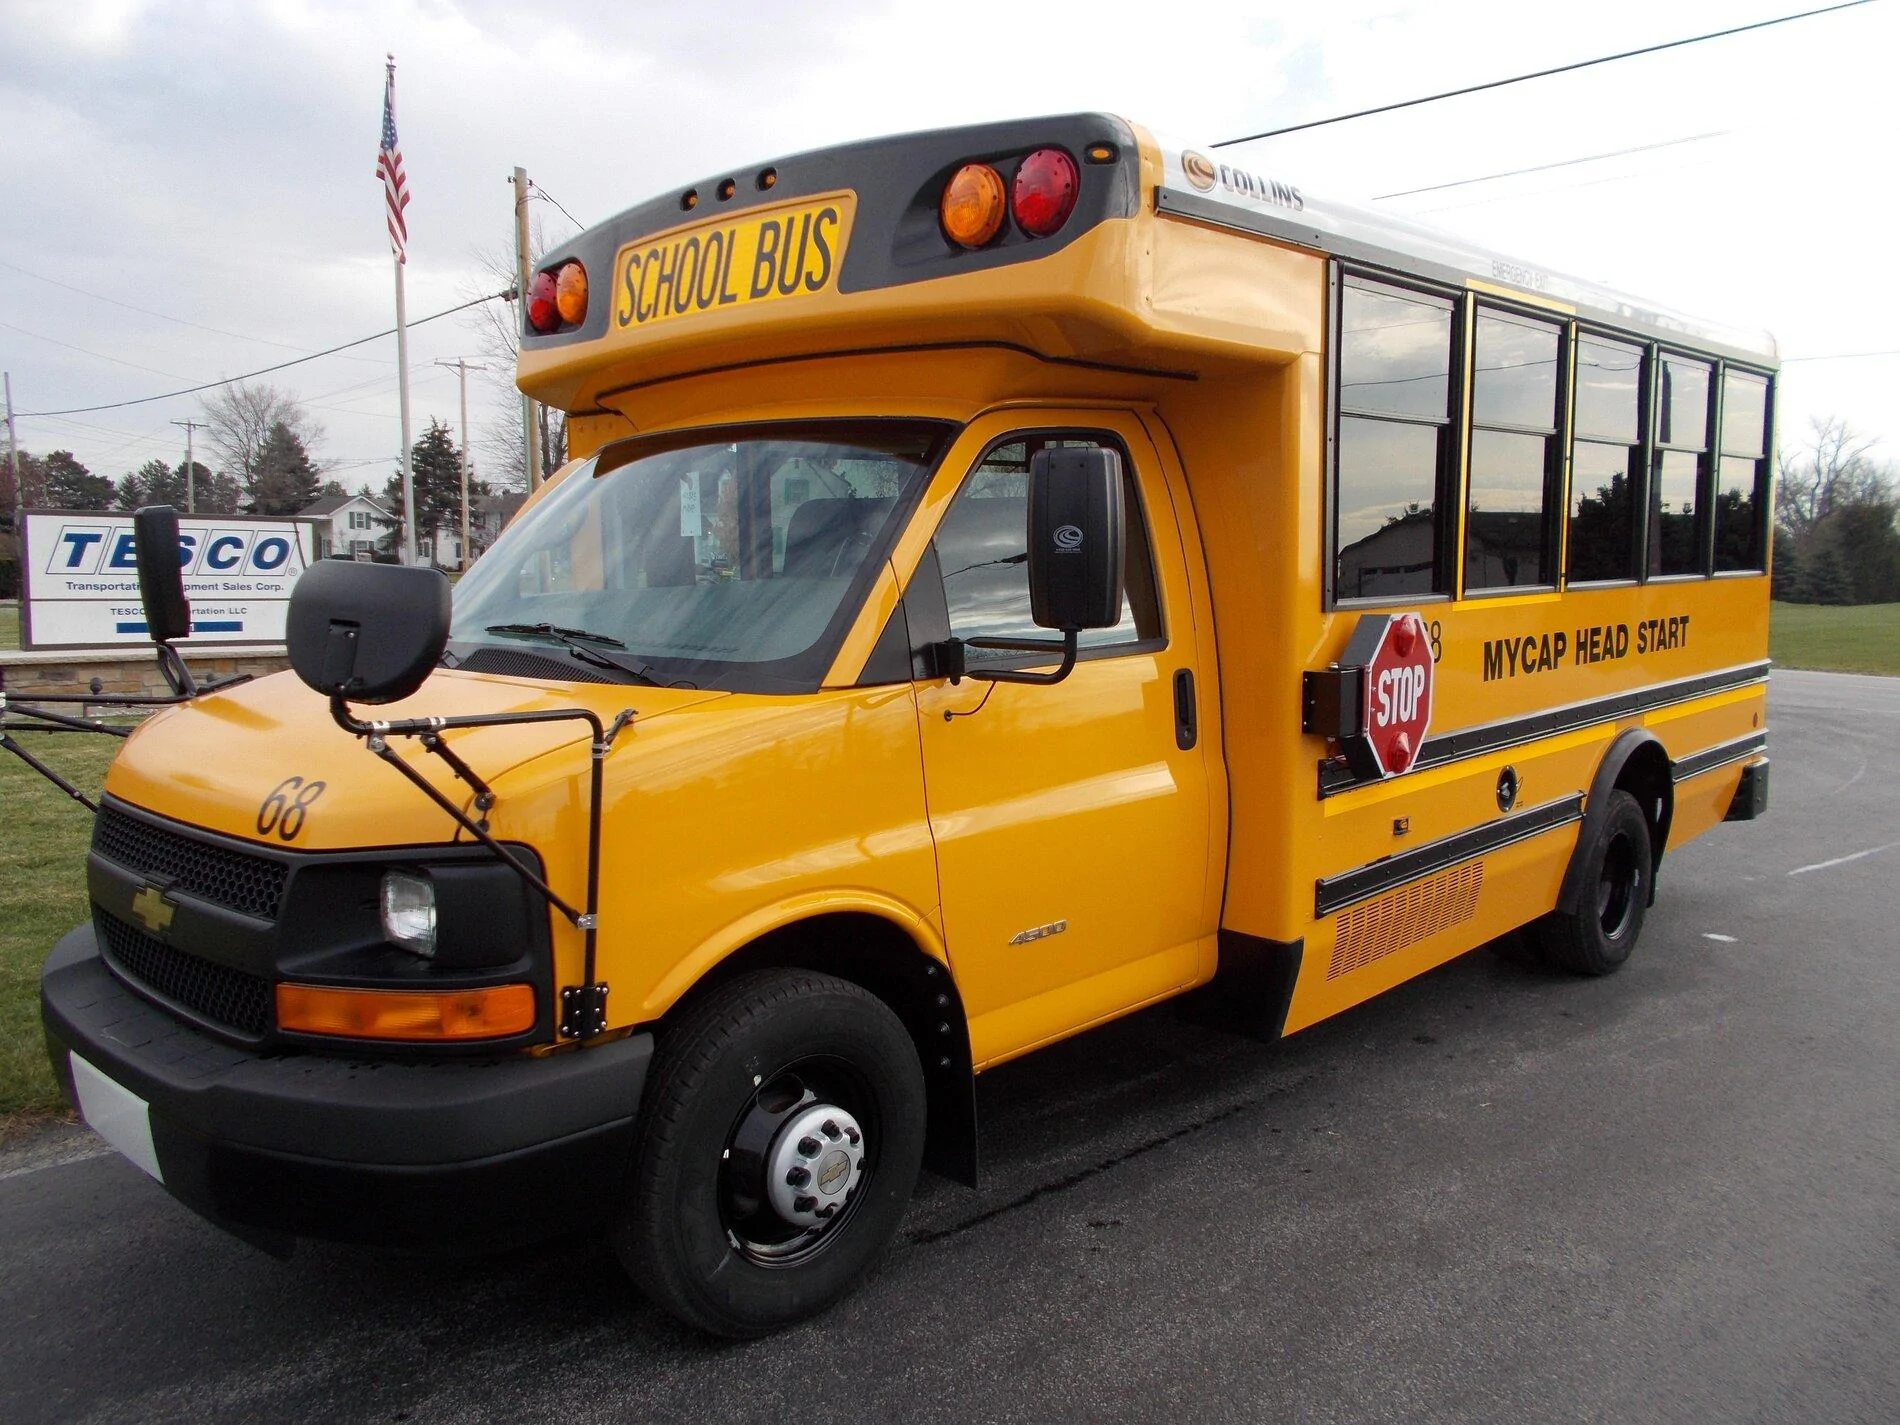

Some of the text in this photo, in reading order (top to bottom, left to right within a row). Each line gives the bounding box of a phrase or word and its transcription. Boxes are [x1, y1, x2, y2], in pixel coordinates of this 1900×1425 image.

[1219, 163, 1304, 212] COLLINS
[618, 207, 838, 328] SCHOOL BUS
[65, 581, 141, 593] Transportati
[222, 582, 252, 591] Sales
[255, 582, 284, 593] Corp.
[110, 607, 146, 616] TESCO
[229, 607, 248, 615] LLC
[1422, 620, 1442, 664] 8
[1483, 615, 1690, 682] MYCAP HEAD START
[1377, 664, 1425, 727] STOP
[256, 776, 327, 841] 68
